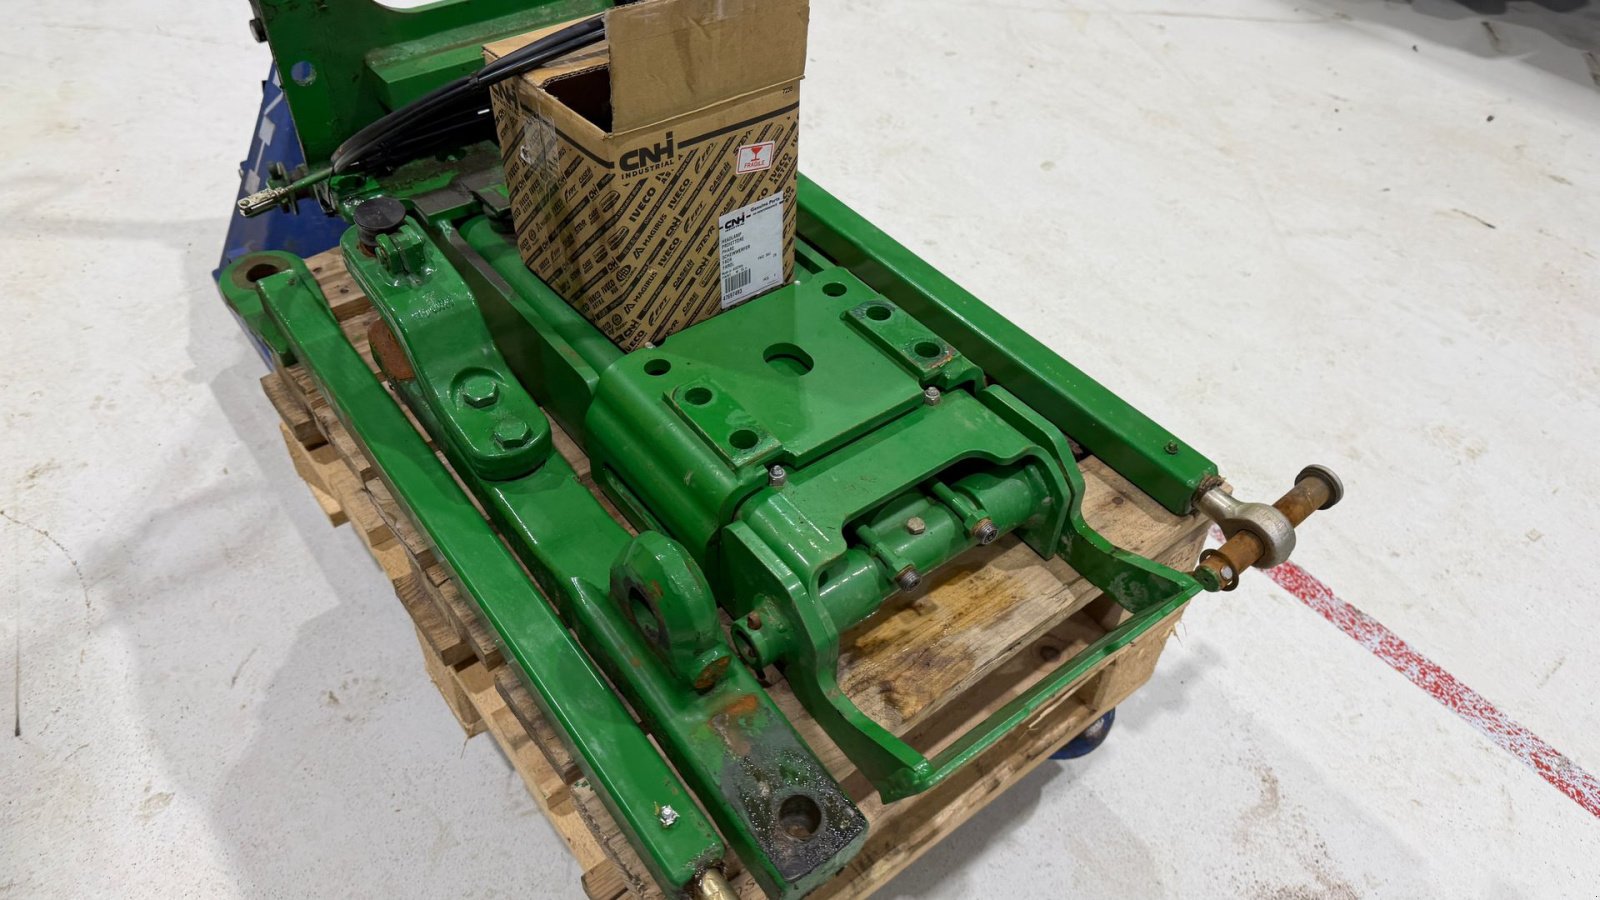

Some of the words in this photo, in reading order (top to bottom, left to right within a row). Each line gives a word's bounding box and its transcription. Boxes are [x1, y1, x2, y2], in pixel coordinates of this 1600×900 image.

[619, 131, 674, 171] CNH
[744, 160, 765, 169] FRAGILE
[621, 160, 674, 180] INDUSTRIAL
[769, 152, 789, 182] IVECO
[629, 187, 656, 222] IVECO
[668, 178, 690, 209] IVECO
[642, 213, 667, 247] MAGIRUS
[666, 216, 681, 238] CNH
[725, 212, 745, 230] CNH
[658, 237, 680, 267] IVECO
[695, 225, 715, 254] STEYR
[695, 256, 709, 276] CNH
[633, 271, 658, 303] MAGIRUS
